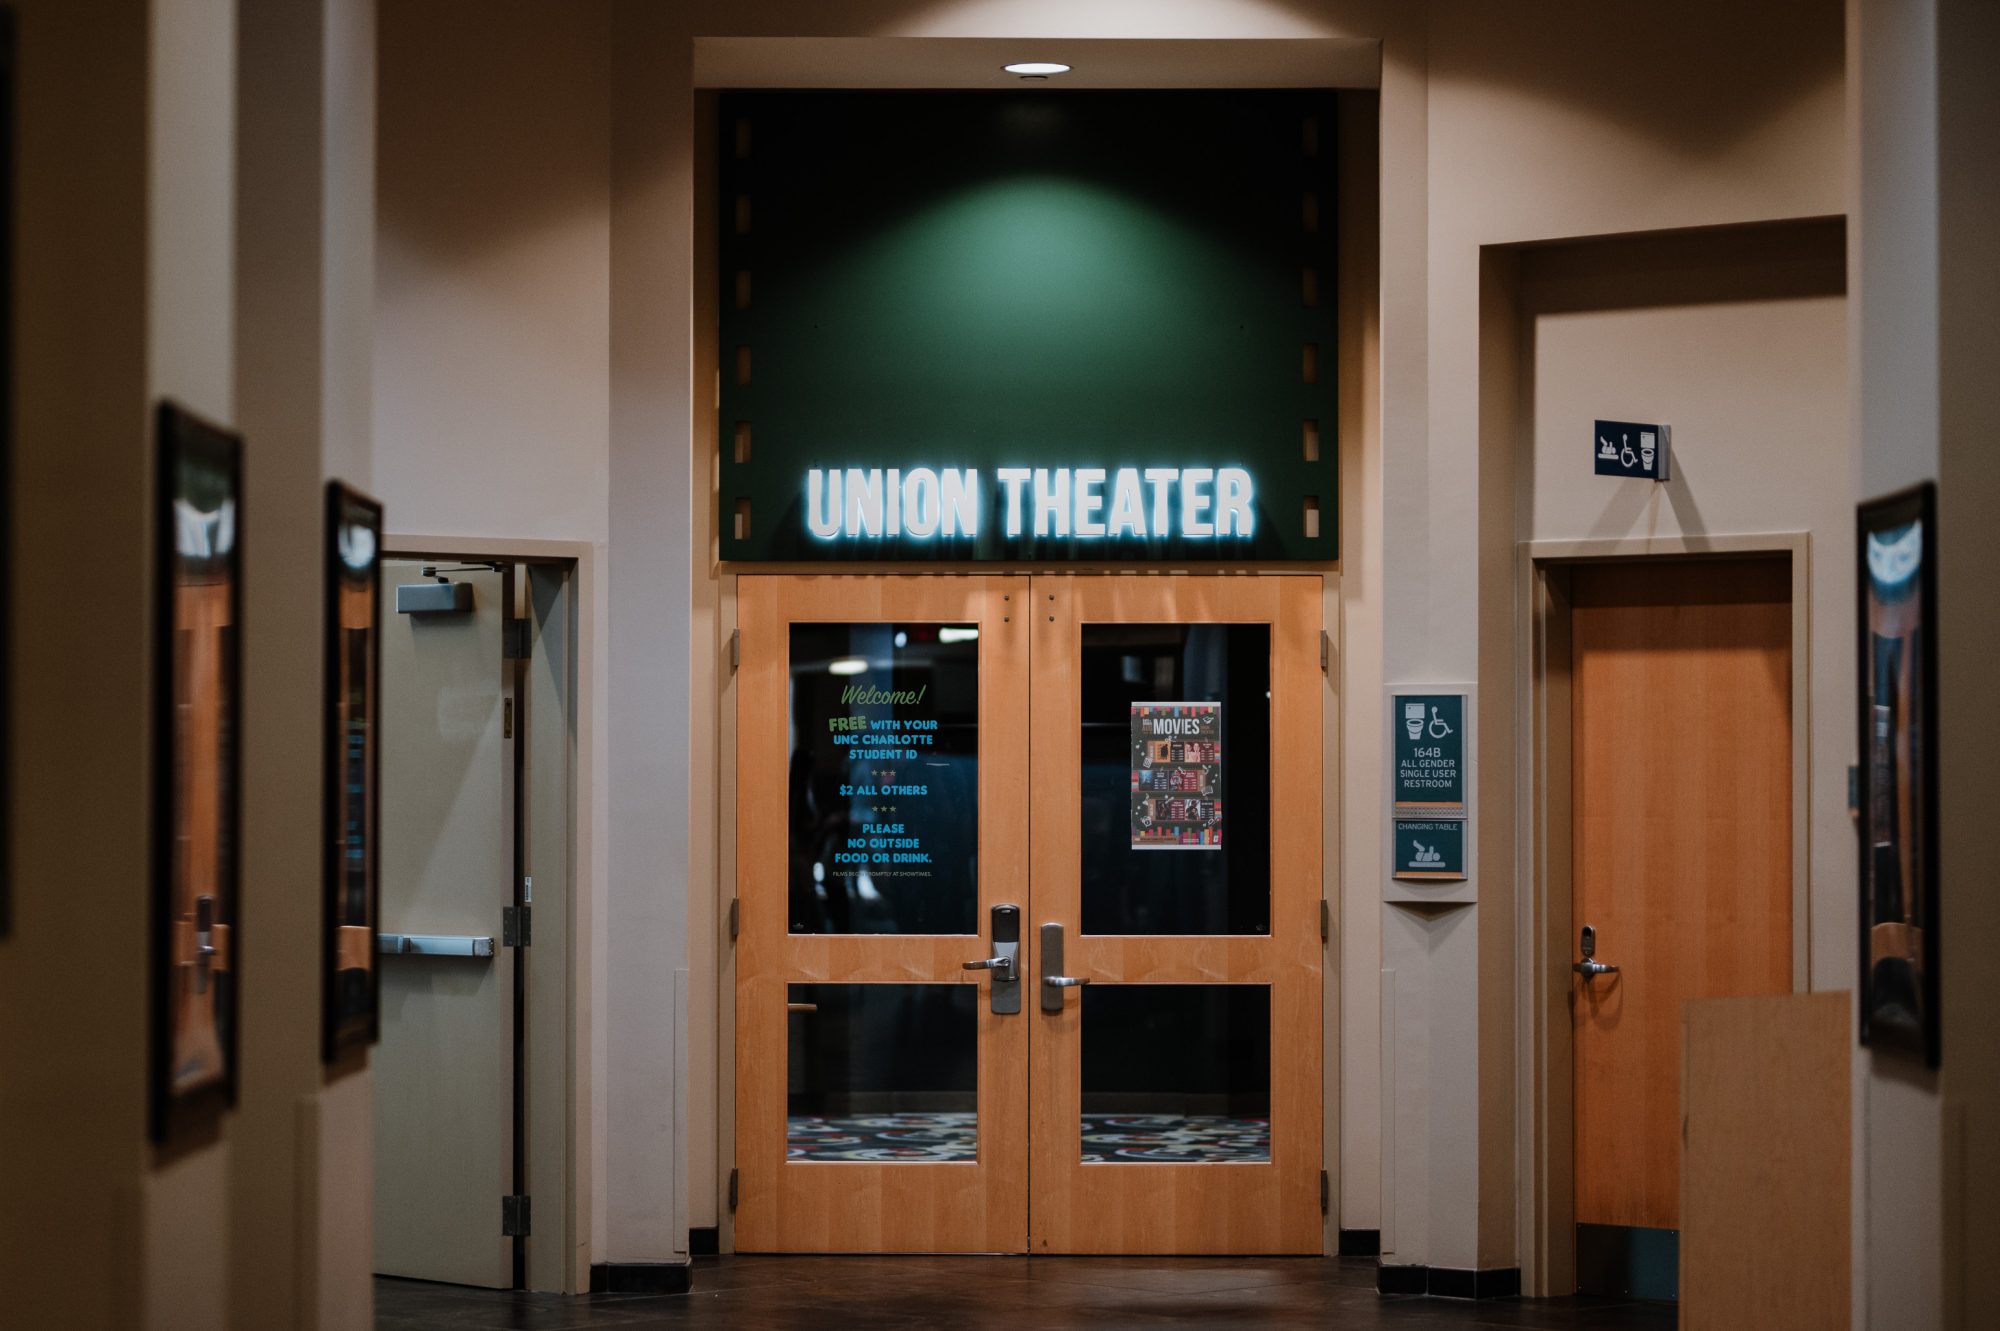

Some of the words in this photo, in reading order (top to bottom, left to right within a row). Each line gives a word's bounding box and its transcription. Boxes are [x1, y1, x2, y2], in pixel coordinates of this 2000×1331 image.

[807, 467, 978, 537] UNION
[997, 467, 1253, 537] THEATER
[841, 684, 927, 705] Welcome!
[828, 715, 867, 732] FREE
[870, 720, 900, 730] WITH
[904, 720, 938, 730] YOUR
[1153, 718, 1200, 735] MOVIES
[833, 735, 859, 745] UNC
[862, 735, 933, 745] CHARLOTTE
[849, 750, 902, 760] STUDENT
[905, 750, 918, 760] ID
[1413, 748, 1441, 758] 164B
[1401, 760, 1417, 768] ALL
[1419, 760, 1455, 768] GENDER
[1400, 769, 1430, 778] SINGLE
[1432, 770, 1457, 778] USER
[1404, 780, 1452, 788] RESTROOM
[839, 784, 853, 797] $2
[856, 785, 878, 795] ALL
[881, 785, 928, 795] OTHERS
[862, 823, 905, 834] PLEASE
[1398, 823, 1434, 831] CHANGING
[1435, 823, 1458, 831] TABLE
[847, 838, 866, 848] NO
[869, 838, 920, 848] OUTSIDE
[834, 853, 868, 863] FOOD
[872, 853, 890, 863] OR
[892, 853, 933, 863] DRINK.
